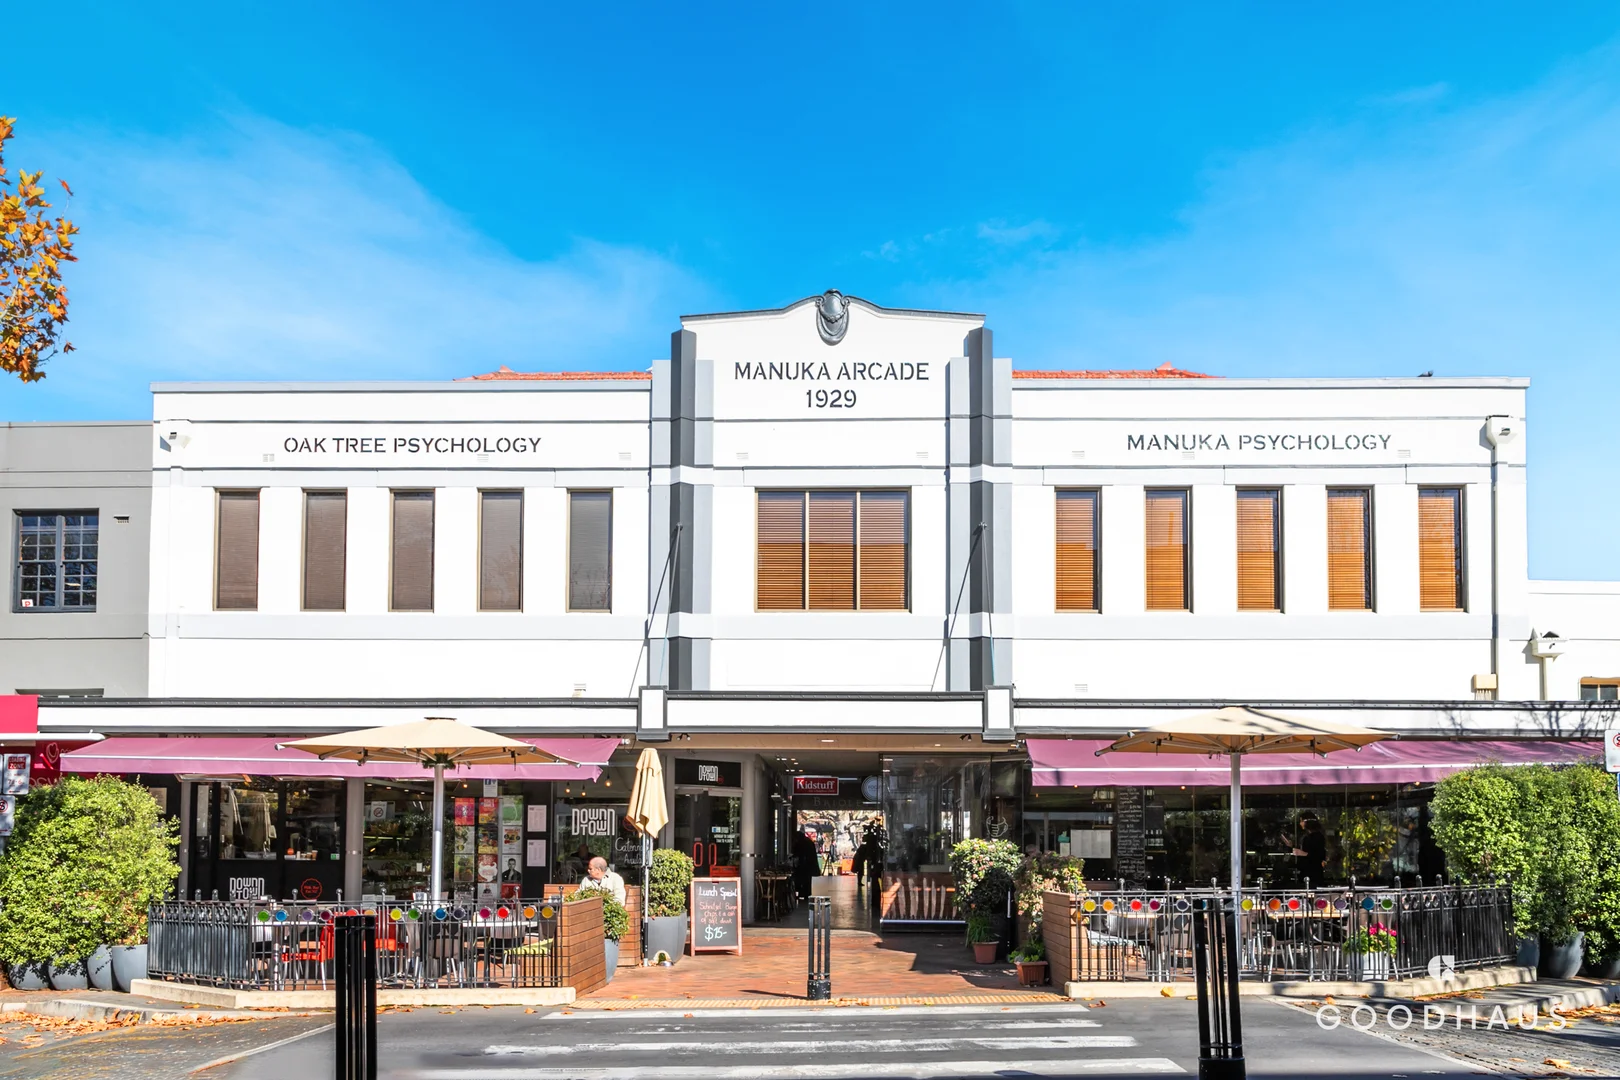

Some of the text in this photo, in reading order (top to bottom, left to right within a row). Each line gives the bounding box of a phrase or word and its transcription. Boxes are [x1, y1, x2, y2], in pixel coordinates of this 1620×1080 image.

[734, 362, 930, 381] MANUKA ARCADE
[806, 389, 857, 408] 1929
[283, 437, 542, 453] OAK TREE PSYCHOLOGY
[1127, 434, 1392, 451] MANUKA PSYCHOLOGY
[796, 779, 835, 790] Kidstuff
[699, 885, 718, 897] Lunch
